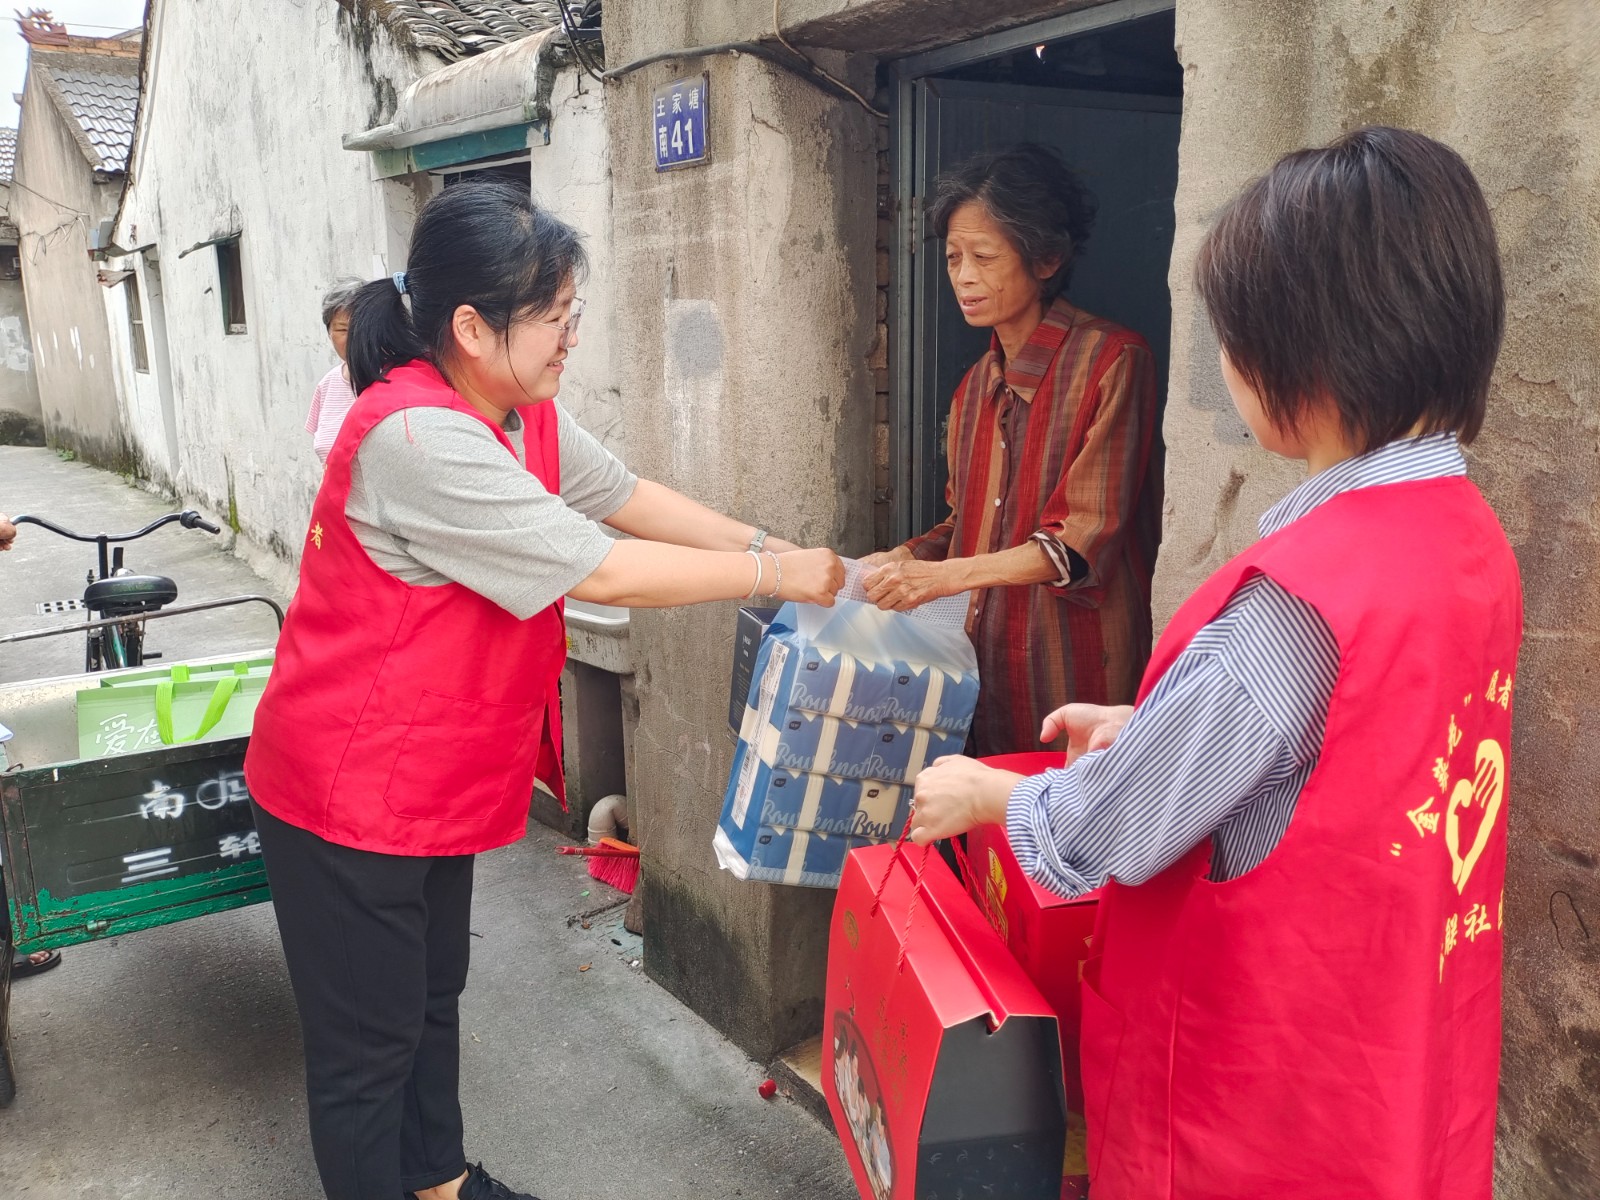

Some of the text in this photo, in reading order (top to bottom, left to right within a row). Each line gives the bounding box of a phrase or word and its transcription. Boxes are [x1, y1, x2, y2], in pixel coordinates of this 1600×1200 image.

[656, 87, 699, 118] 王家塘
[310, 521, 323, 550] 者
